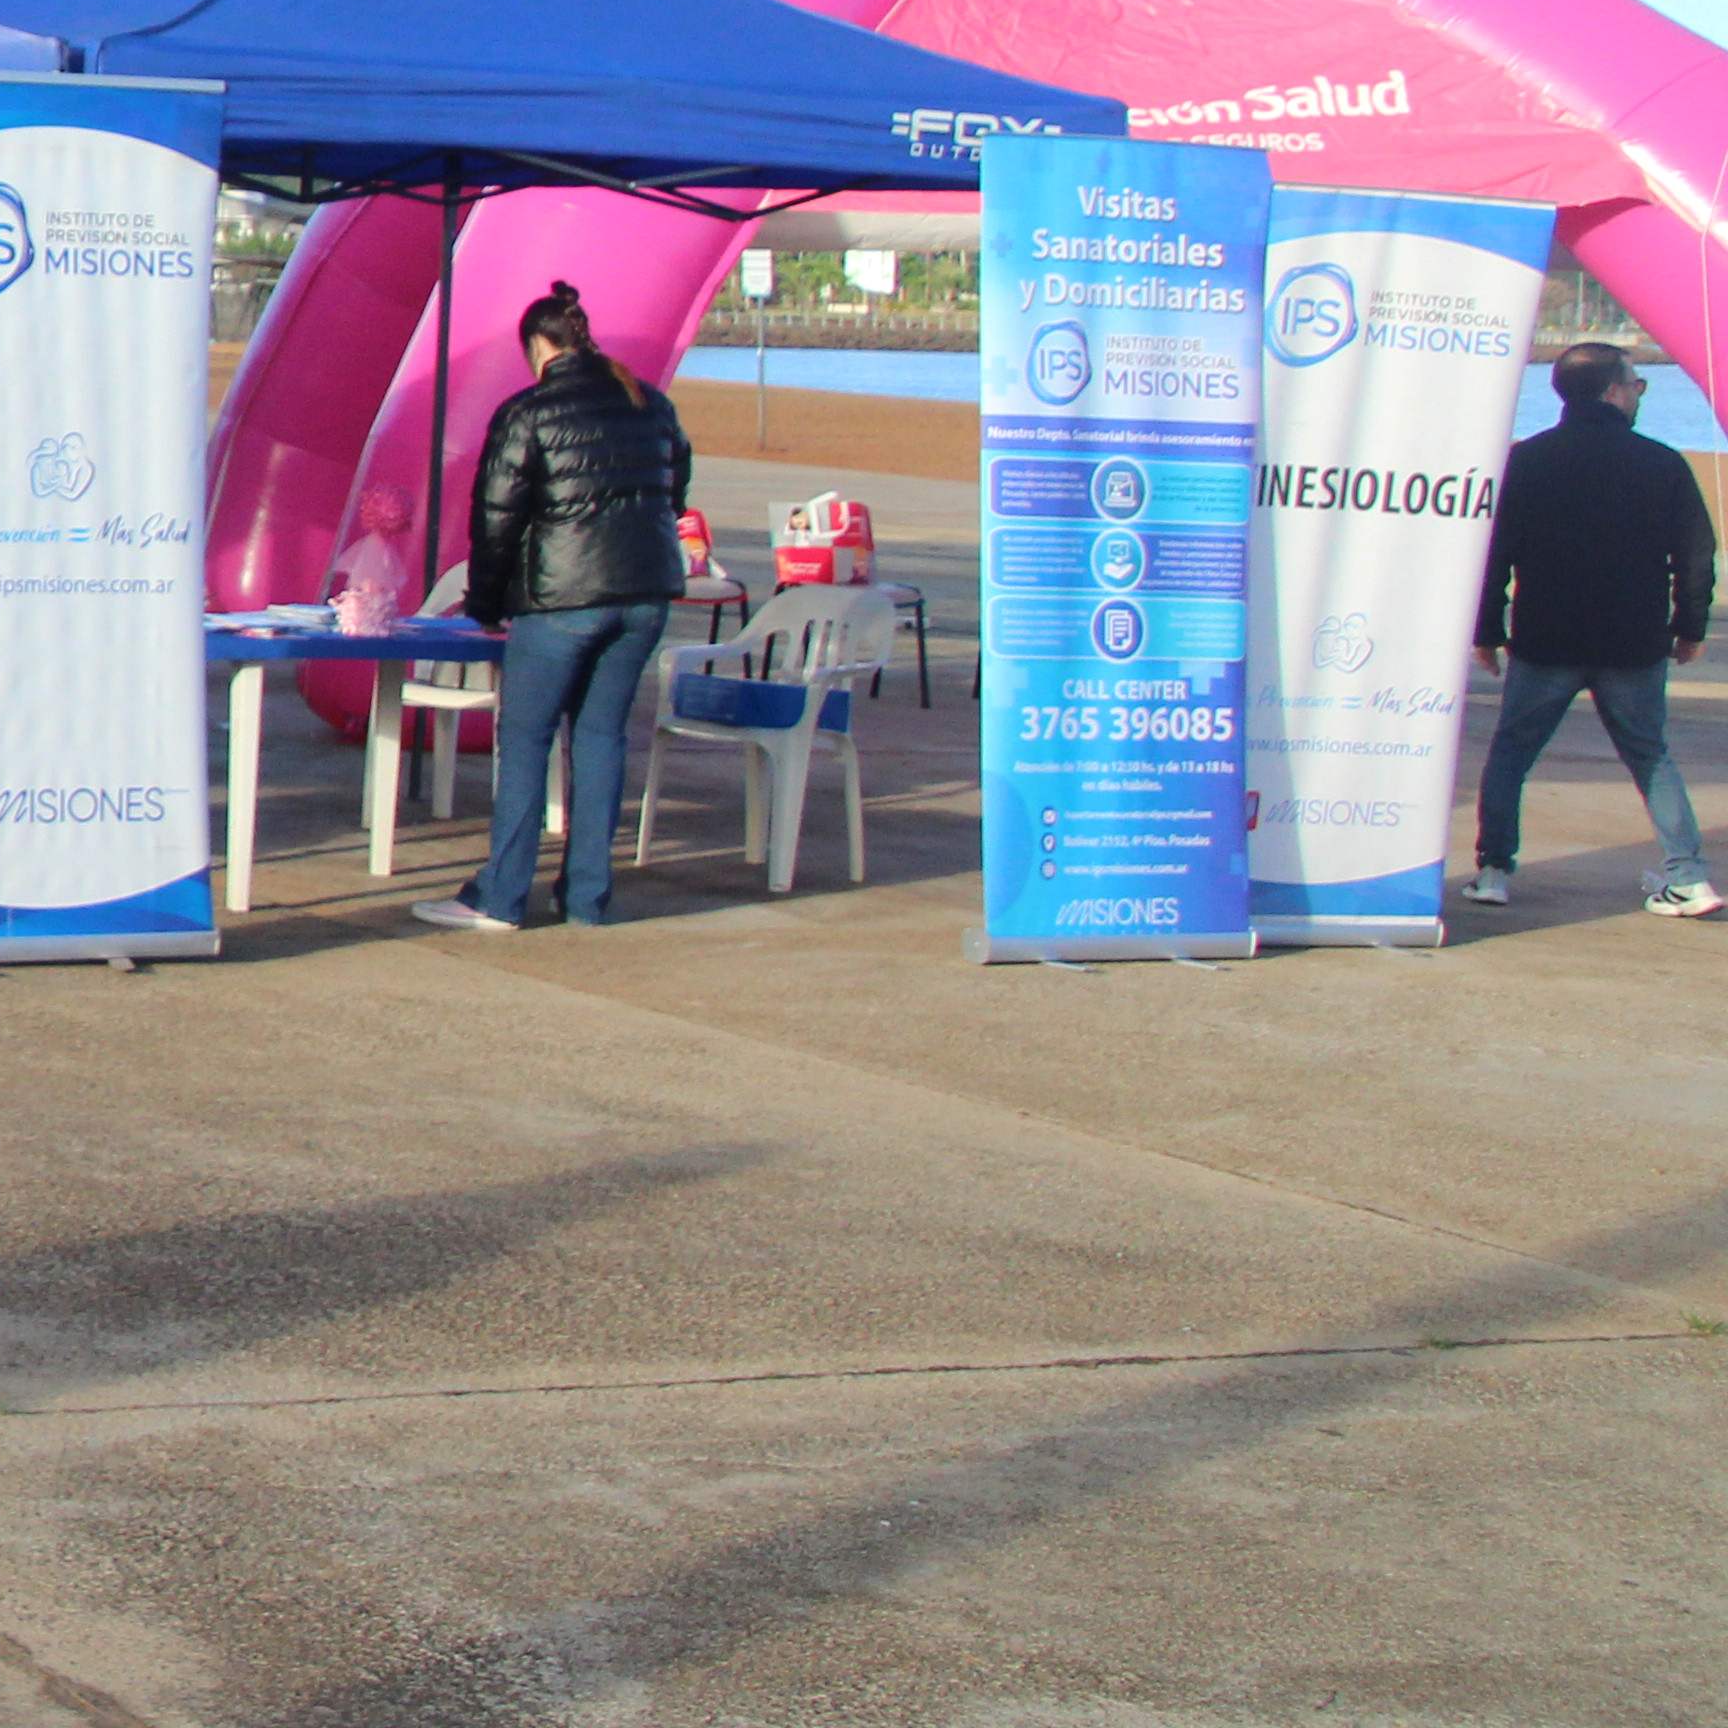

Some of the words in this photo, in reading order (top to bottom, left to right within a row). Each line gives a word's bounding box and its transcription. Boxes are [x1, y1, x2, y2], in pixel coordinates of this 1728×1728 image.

[1244, 68, 1411, 121] Salud
[1077, 185, 1177, 221] Visitas
[45, 211, 129, 227] INSTITUTO
[133, 214, 154, 228] DE
[45, 228, 128, 244] PREVISIÓN
[132, 231, 190, 246] SOCIAL
[1031, 227, 1225, 268] Sanatoriales
[44, 247, 194, 278] MISIONES
[1019, 279, 1037, 312] y
[1045, 273, 1246, 314] Domiciliarias
[1372, 290, 1451, 309] INSTITUTO
[1455, 297, 1476, 310] DE
[1281, 297, 1341, 337] IPS
[1369, 306, 1448, 323] PREVISIÓN
[1452, 312, 1510, 327] SOCIAL
[1106, 336, 1177, 350] INSTITUTO
[1182, 338, 1202, 351] DE
[1364, 324, 1511, 358] MISIONES
[1038, 348, 1083, 380] IPS
[1181, 355, 1237, 369] SOCIAL
[1104, 369, 1240, 399] MISIONES
[1256, 462, 1496, 519] INESIOLOGÍA
[139, 512, 192, 549] Salud
[1062, 679, 1110, 700] CALL
[1114, 680, 1188, 701] CENTER
[1406, 687, 1456, 717] Salud
[1019, 706, 1100, 742] 3765
[1108, 707, 1234, 742] 396085
[1265, 799, 1401, 827] MISIONES
[1055, 897, 1181, 926] MISIONES
